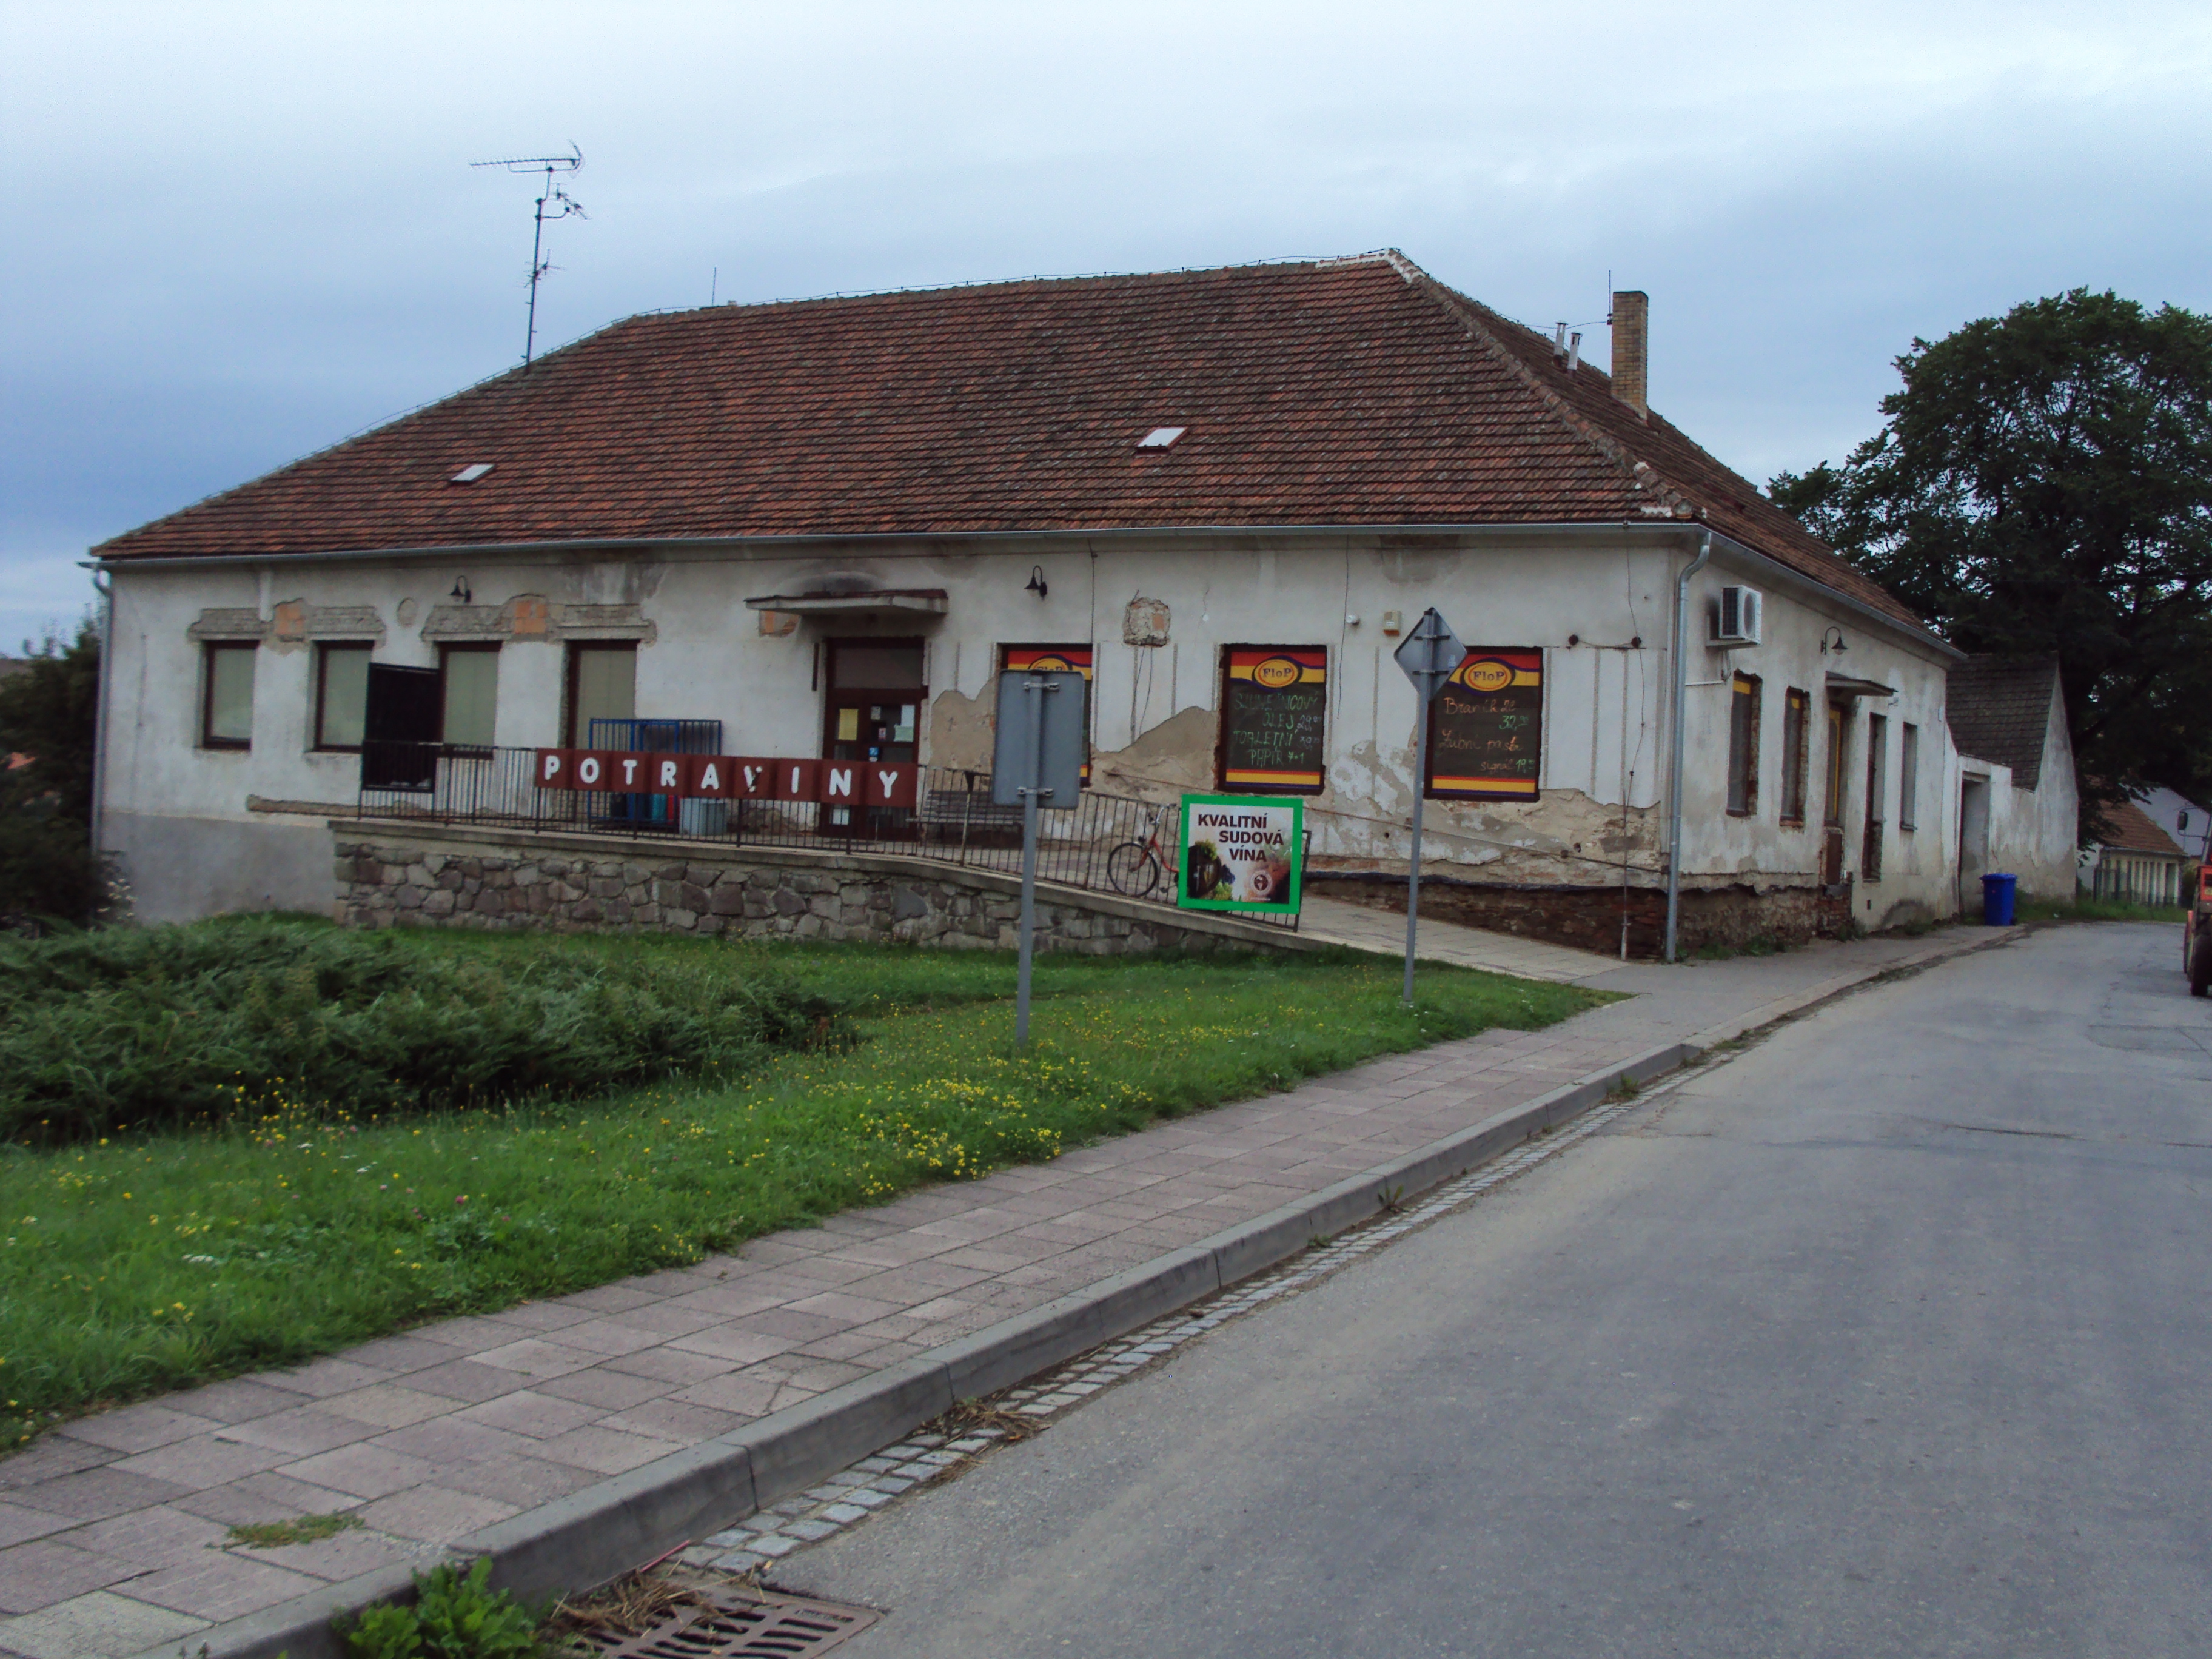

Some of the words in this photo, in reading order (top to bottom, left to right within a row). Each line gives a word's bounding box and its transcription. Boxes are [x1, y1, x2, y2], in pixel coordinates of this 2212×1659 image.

[545, 755, 897, 798] POTRAVINY
[1198, 813, 1267, 829] KVALITNÍ
[1219, 829, 1284, 845] SUDOVÁ
[1229, 845, 1267, 862] VÍNA
